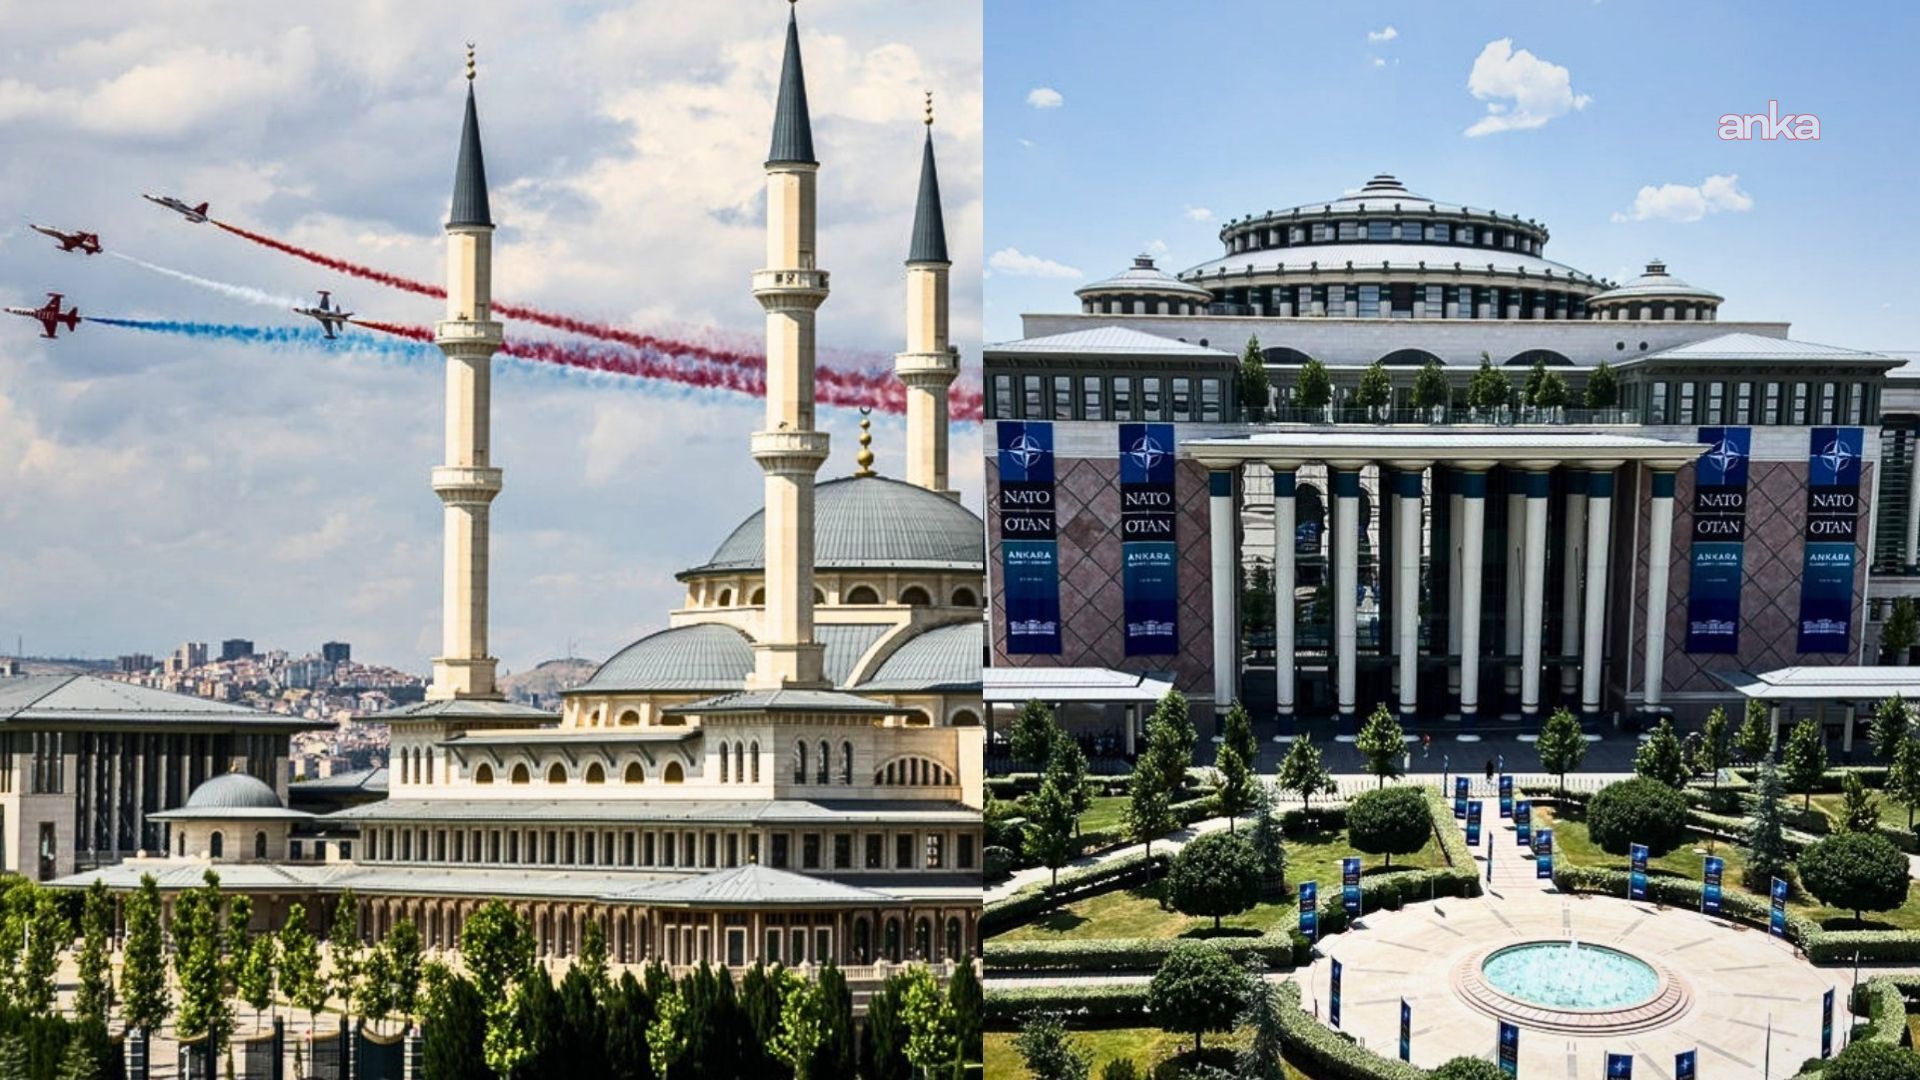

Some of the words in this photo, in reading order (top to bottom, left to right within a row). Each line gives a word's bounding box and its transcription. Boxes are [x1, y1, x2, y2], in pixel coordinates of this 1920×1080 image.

[1004, 490, 1050, 503] NATO
[1126, 492, 1170, 506] NATO
[1700, 493, 1742, 507] NATO
[1812, 493, 1854, 507] NATO
[1004, 517, 1050, 531] OTAN
[1125, 520, 1170, 533] OTAN
[1697, 520, 1740, 534] OTAN
[1810, 520, 1852, 534] OTAN
[1008, 551, 1051, 560] ANKARA
[1128, 553, 1171, 561] ANKARA
[1697, 553, 1737, 561] ANKARA
[1810, 553, 1850, 561] ANKARA
